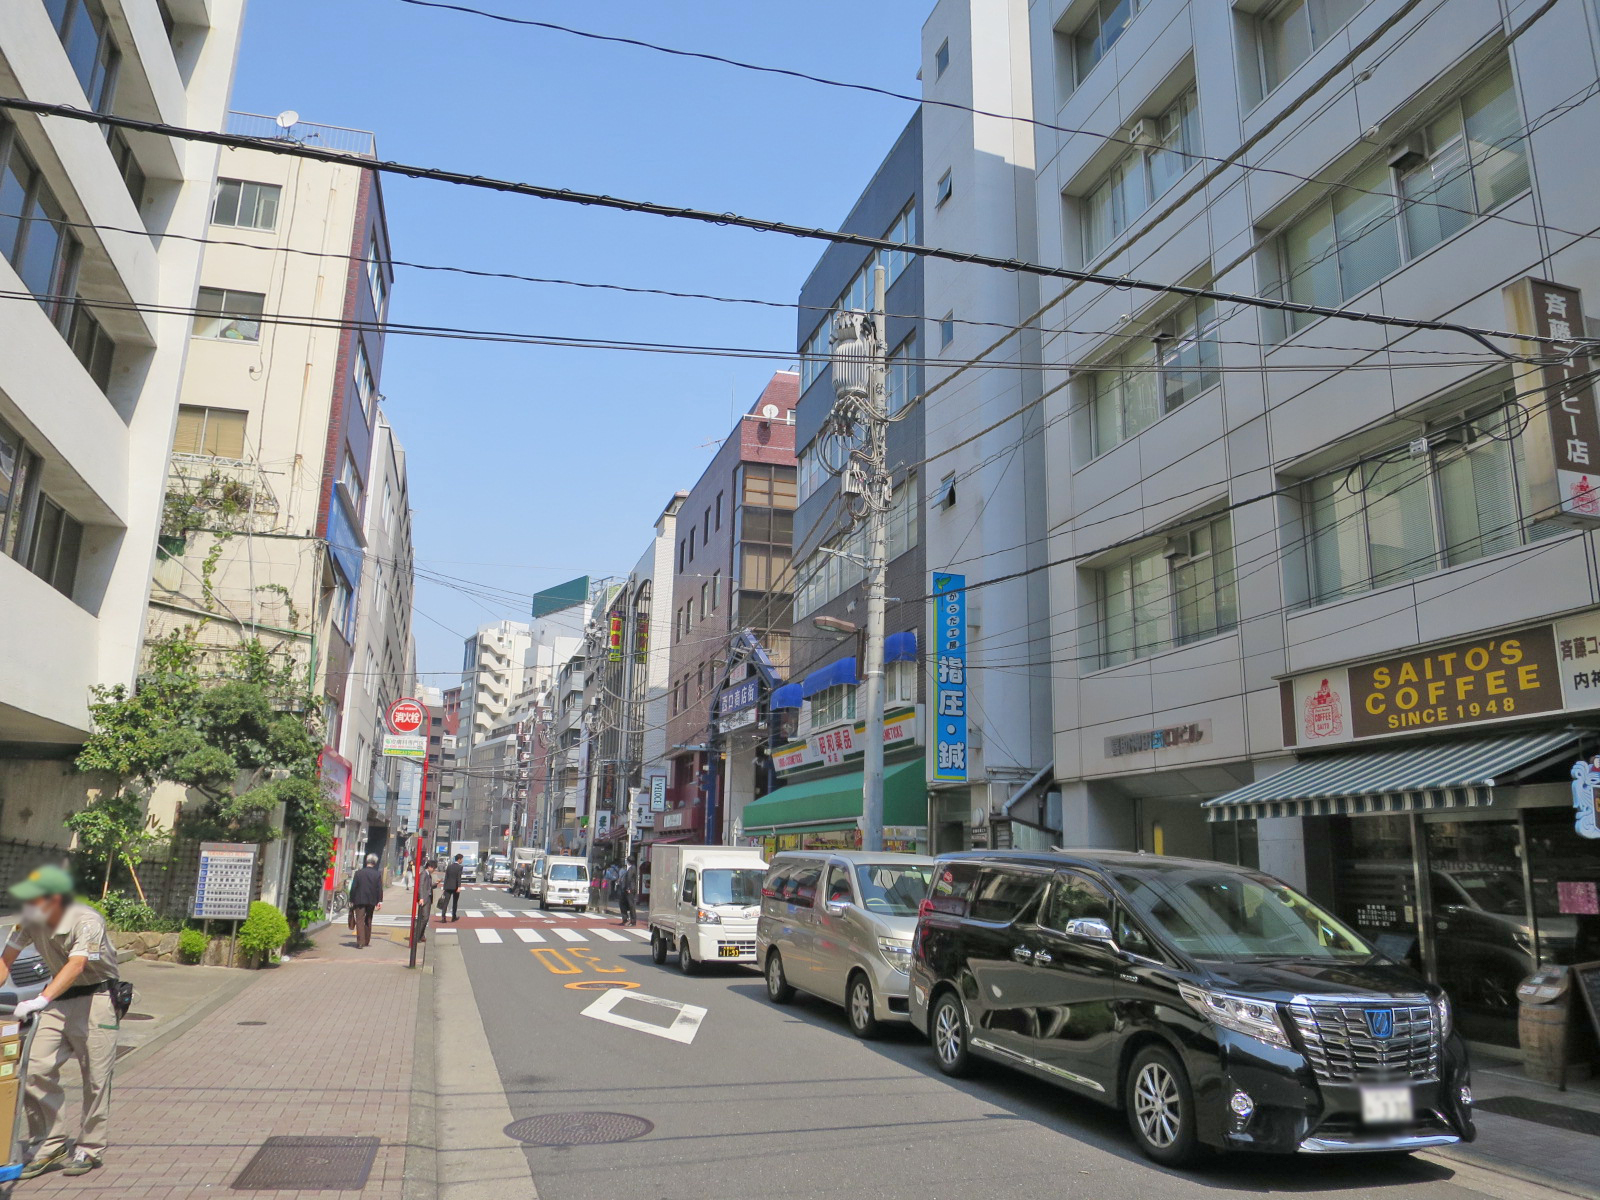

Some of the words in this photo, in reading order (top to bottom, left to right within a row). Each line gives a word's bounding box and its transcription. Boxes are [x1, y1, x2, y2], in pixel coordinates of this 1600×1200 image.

[1373, 639, 1523, 690] SAITO'S
[1365, 663, 1541, 715] COFFEE
[395, 712, 420, 723] 消火栓
[1387, 706, 1449, 729] SINCE
[1456, 697, 1516, 719] 1948
[818, 729, 852, 755] 昭和薬品
